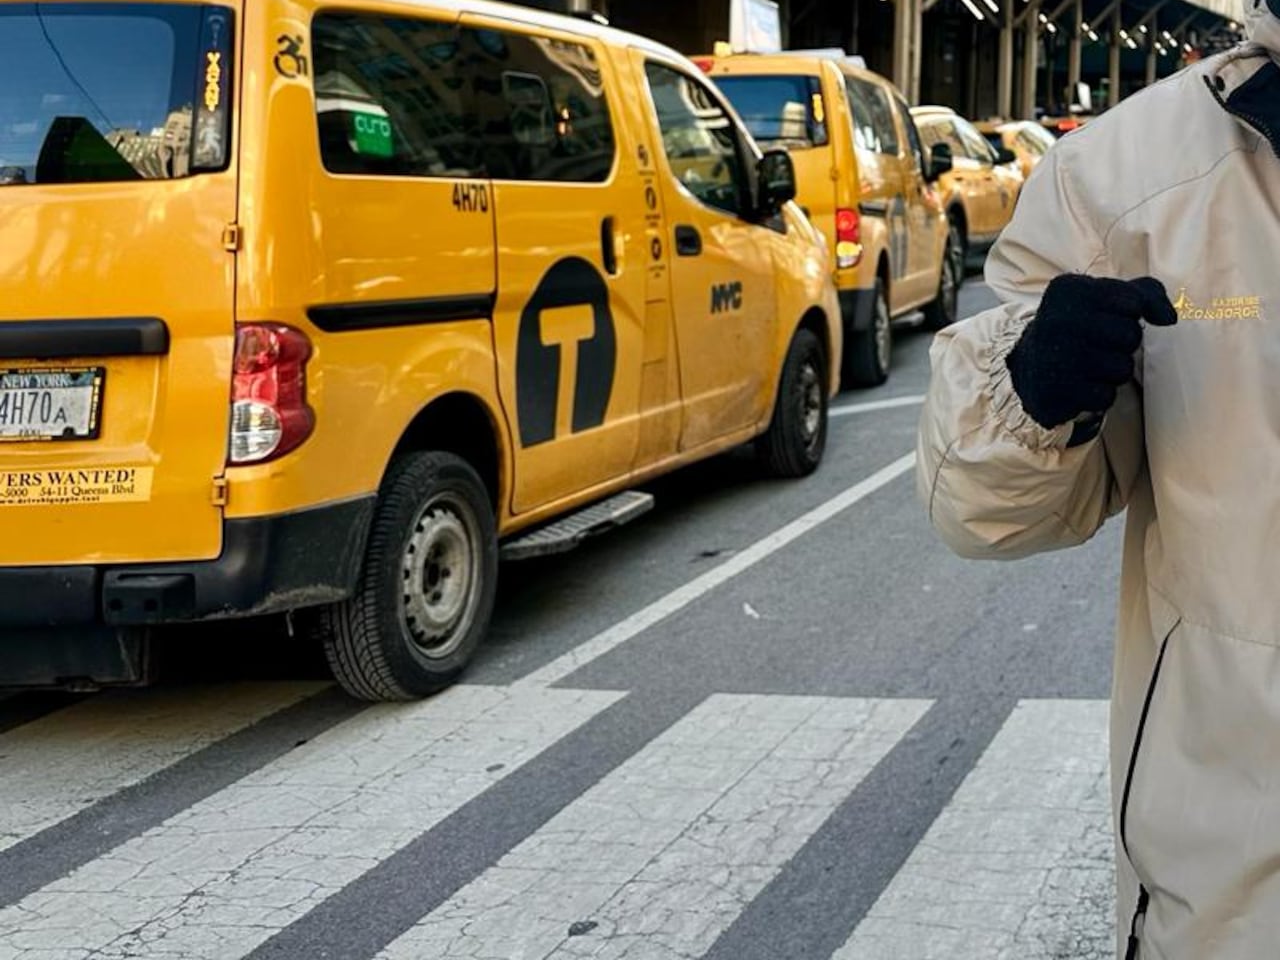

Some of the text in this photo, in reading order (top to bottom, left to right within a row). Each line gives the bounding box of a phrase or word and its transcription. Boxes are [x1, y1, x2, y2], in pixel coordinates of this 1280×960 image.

[452, 183, 488, 212] 4H70
[710, 281, 743, 315] NYC
[2, 372, 70, 388] NEW YORK
[48, 469, 136, 485] WANTED!
[40, 486, 67, 496] 54-11
[71, 485, 109, 496] Queens
[111, 483, 135, 494] Blvd
